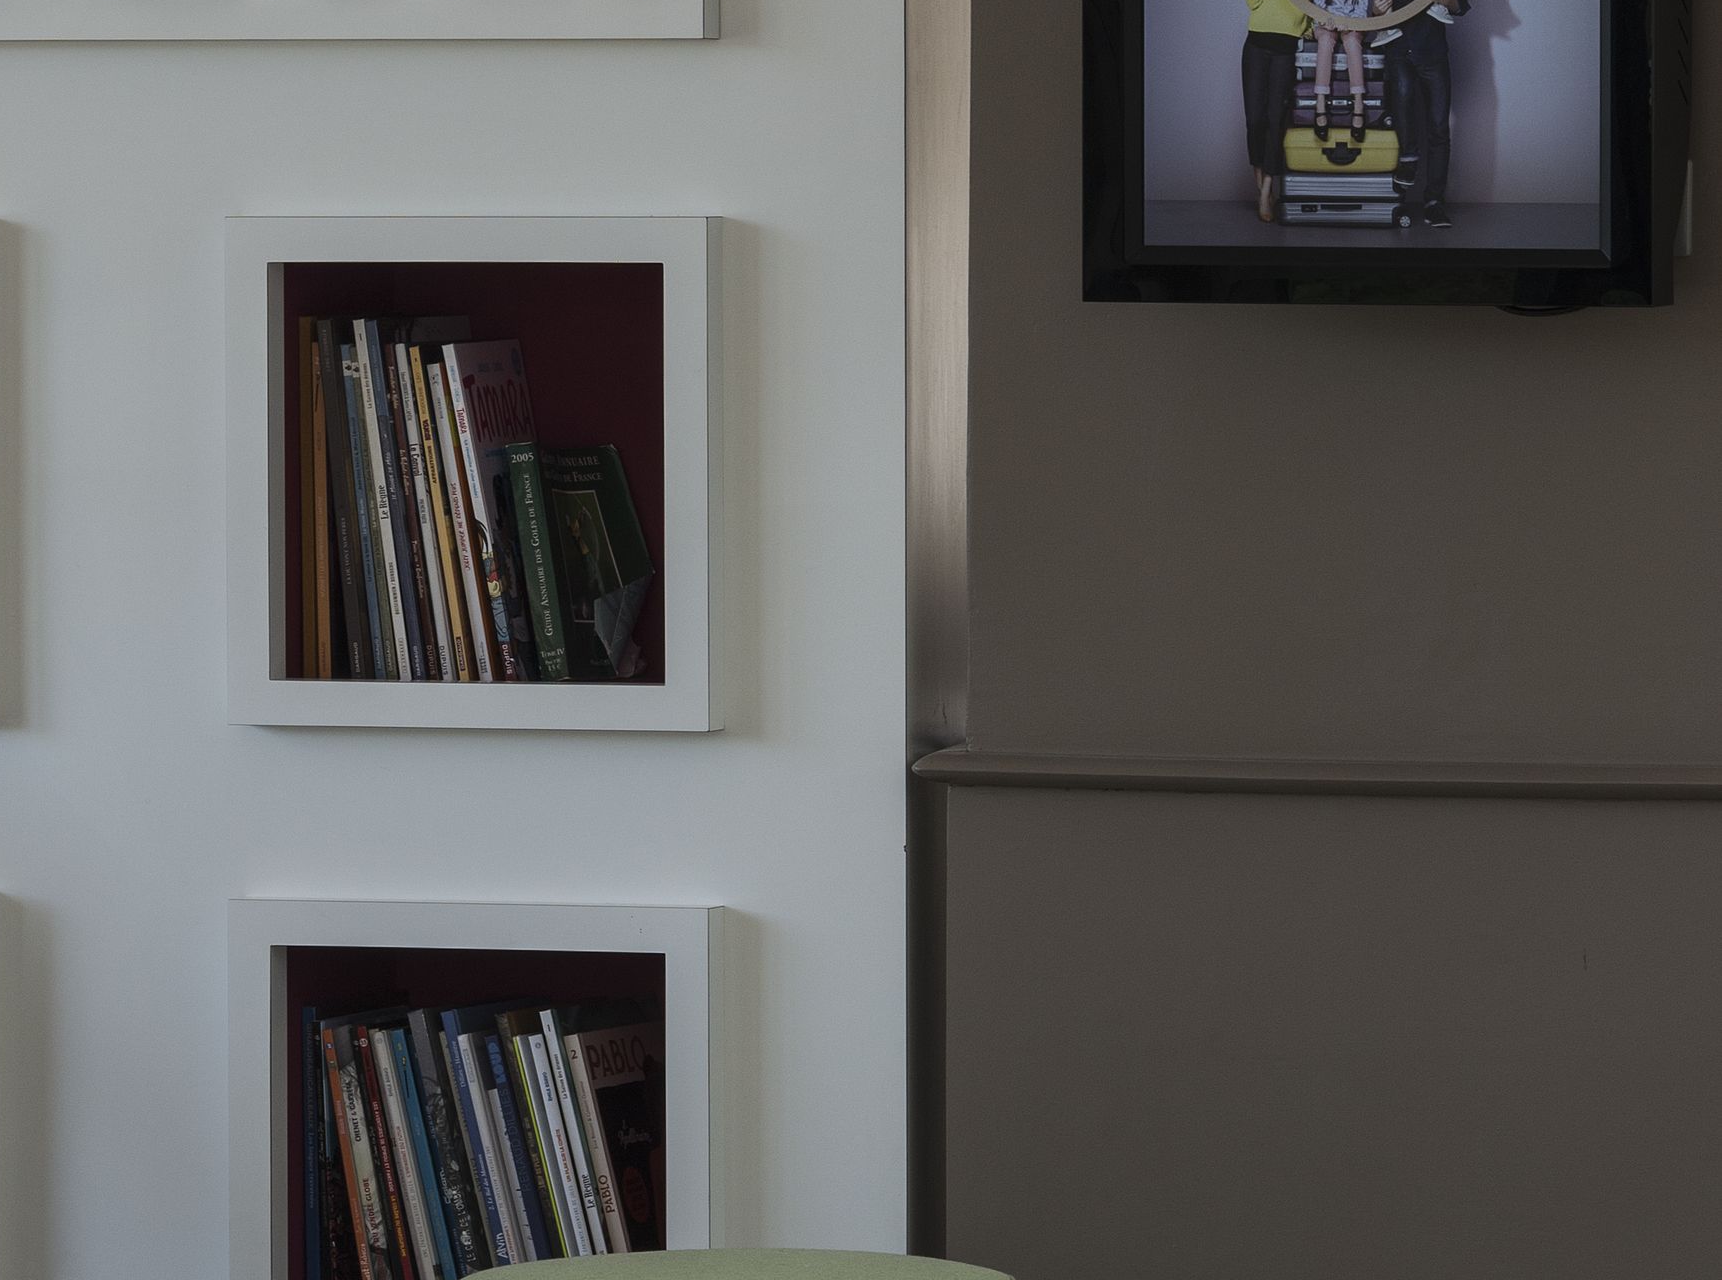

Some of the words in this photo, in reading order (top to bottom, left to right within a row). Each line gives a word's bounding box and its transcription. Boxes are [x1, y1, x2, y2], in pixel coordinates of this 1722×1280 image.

[456, 408, 467, 434] TAMARA
[463, 374, 535, 443] TAMARA
[410, 453, 422, 477] Convoi
[428, 445, 437, 484] APPARITIONS
[511, 451, 534, 464] 2005
[522, 473, 534, 505] FRANCE
[572, 470, 603, 483] FRANCE
[377, 485, 388, 509] Règne
[459, 530, 468, 553] JUMPER
[529, 520, 540, 547] GOLFS
[536, 566, 550, 607] ANNUAIRE
[543, 608, 554, 636] GUIDE
[426, 645, 435, 675] DUPUIS
[439, 645, 448, 676] DUPUIS
[502, 644, 512, 675] DUPUIS
[487, 1041, 507, 1085] LOUP
[585, 1035, 646, 1081] PABLO
[374, 1111, 384, 1138] AVENTURES
[511, 1139, 532, 1193] RENAUD
[363, 1178, 373, 1202] GLOBE
[580, 1173, 594, 1199] Règne
[598, 1174, 616, 1214] PABLO
[367, 1203, 378, 1231] VENDÉE
[494, 1232, 508, 1260] Alvin
